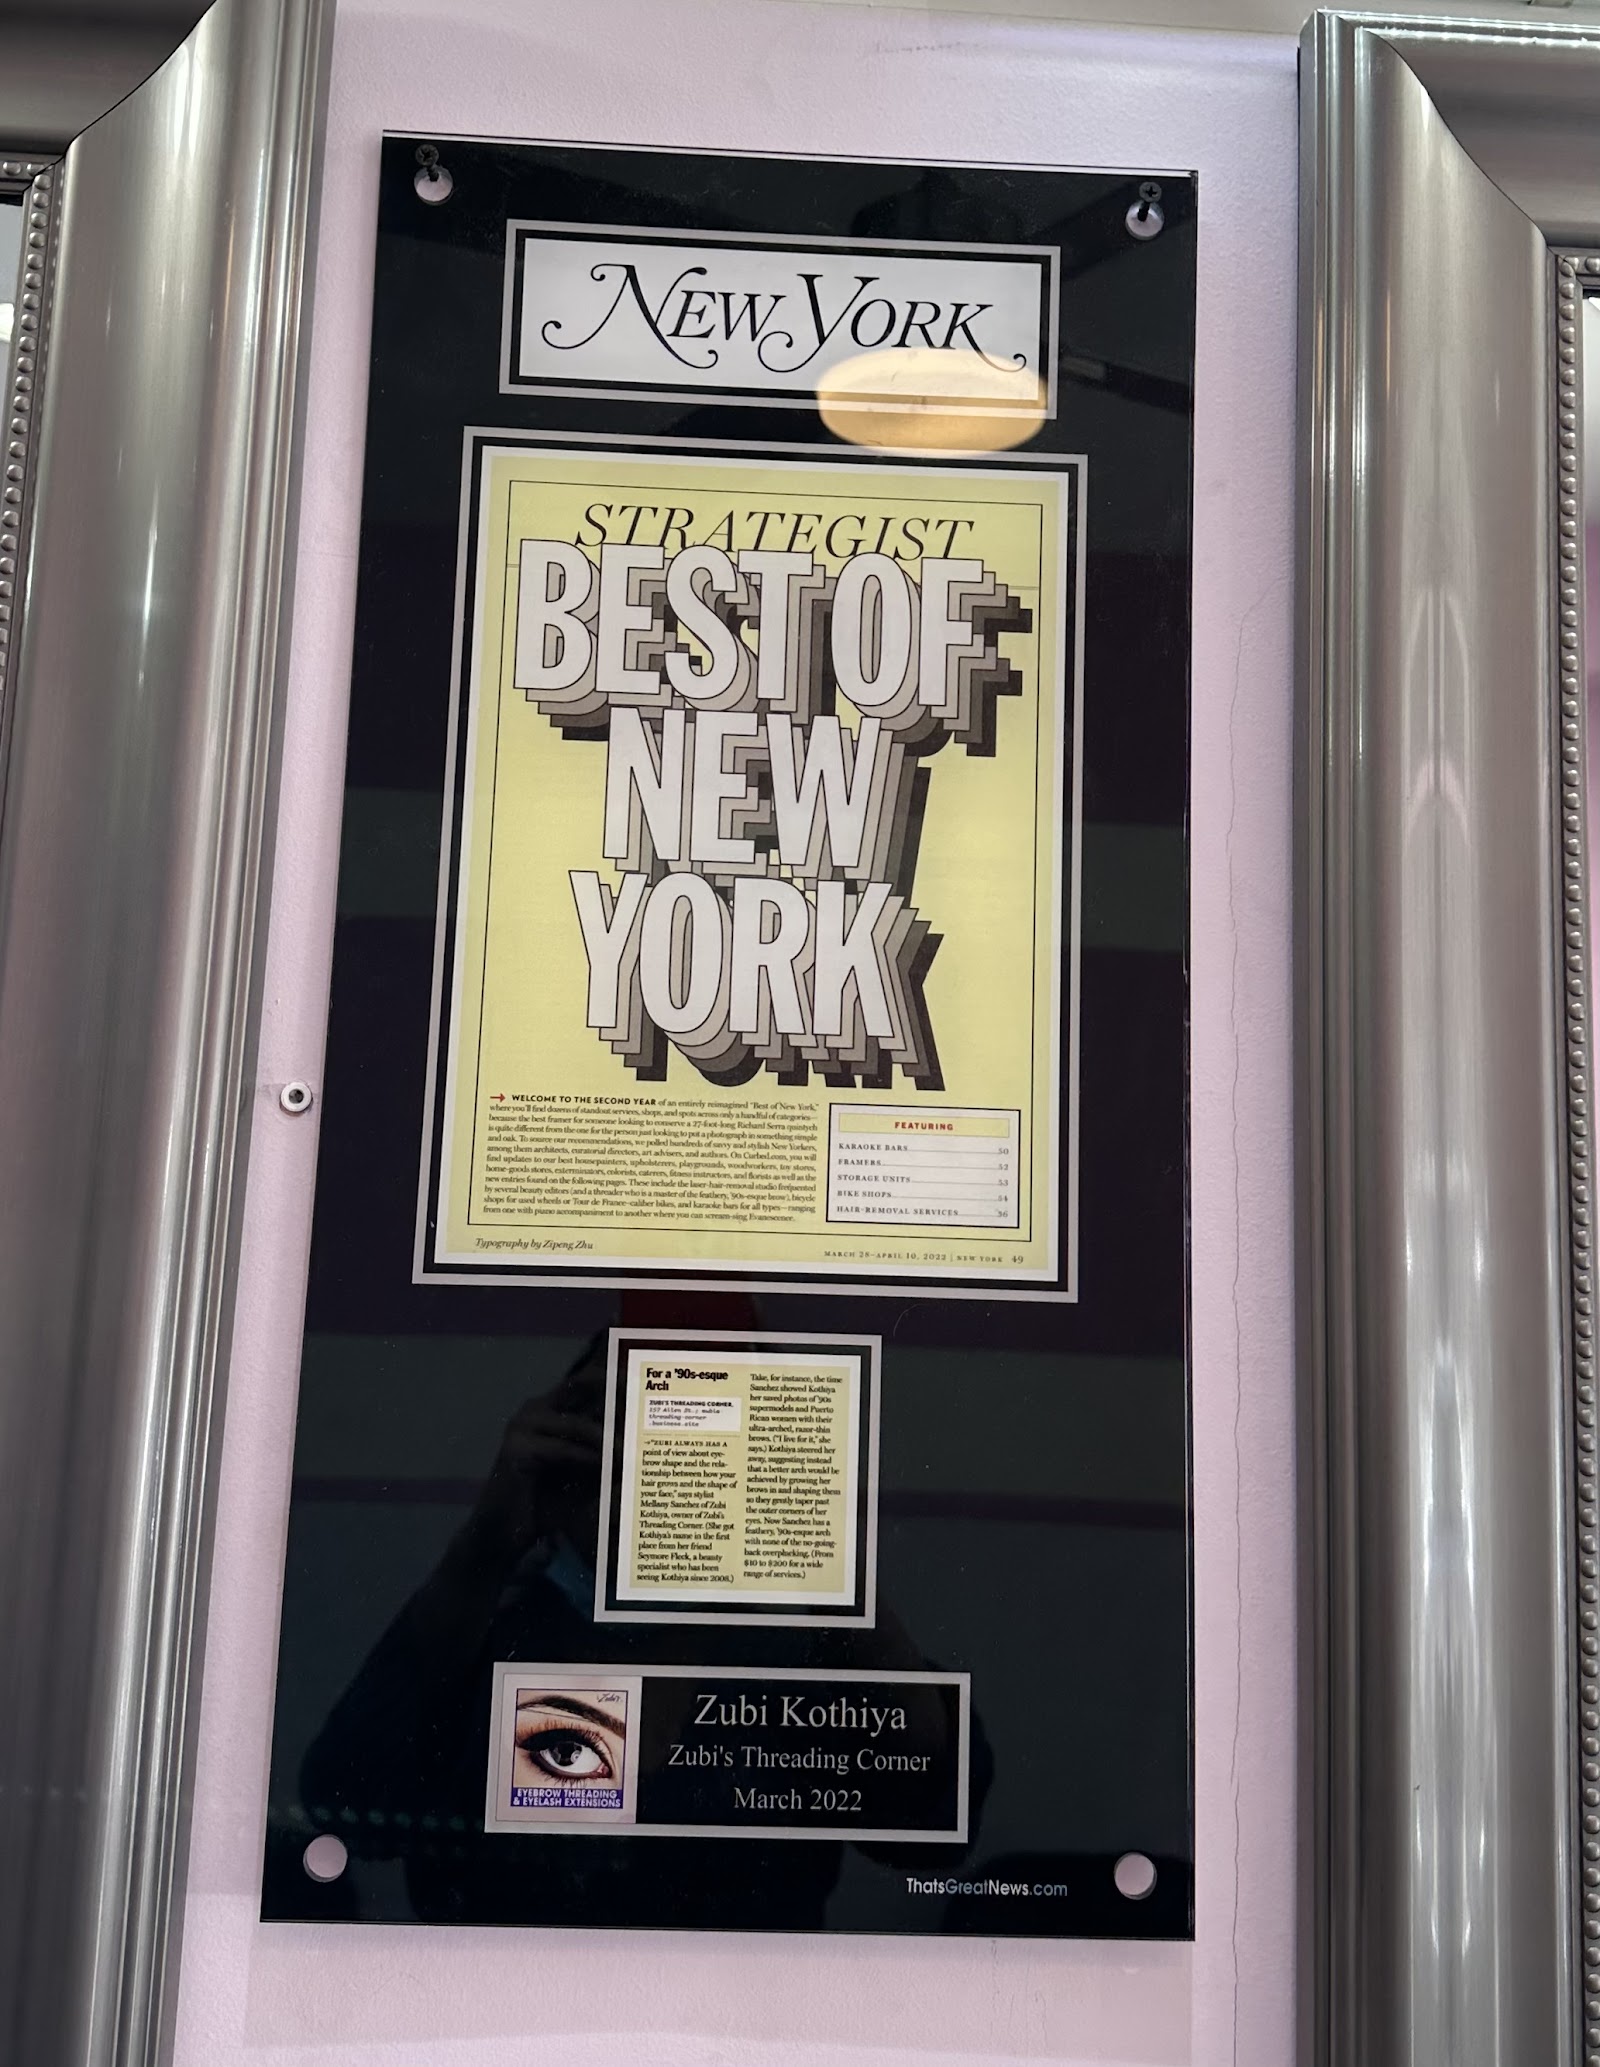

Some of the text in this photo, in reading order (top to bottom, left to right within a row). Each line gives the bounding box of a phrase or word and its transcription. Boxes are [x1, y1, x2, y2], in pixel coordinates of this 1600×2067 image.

[575, 503, 975, 562] STRATEGIST
[513, 538, 998, 717] BEST OF
[602, 706, 892, 872] NEW
[568, 869, 904, 1046] YORK
[512, 1094, 556, 1103] WELCOME
[593, 1096, 630, 1105] SECOND
[894, 1121, 954, 1131] FEATURING
[838, 1142, 882, 1151] KARAOKE
[884, 1144, 908, 1152] BARS
[838, 1158, 881, 1166] FRAMERS
[837, 1174, 879, 1182] STORAGE
[882, 1175, 911, 1183] UNITS
[837, 1190, 860, 1198] BIKE
[862, 1191, 892, 1199] SHOPS
[836, 1206, 910, 1214] HAIR-REMOVAL
[913, 1208, 958, 1216] SERVICES
[475, 1238, 593, 1251] Typography by Zipeng Zhu
[824, 1250, 855, 1258] MARCH
[906, 1252, 920, 1260] 10,
[924, 1253, 946, 1261] 2022
[1012, 1255, 1024, 1264] 49
[646, 1368, 663, 1378] For
[674, 1368, 728, 1382] '90s-esque
[645, 1380, 669, 1390] Arch
[693, 1694, 907, 1736] Zubi Kothiya
[667, 1743, 931, 1775] Zubi's Threading Corner
[516, 1788, 618, 1798] EYEBROW THREADING
[734, 1787, 862, 1812] March 2022
[512, 1797, 621, 1808] & EYELASH EXTENSIONS
[906, 1876, 1068, 1898] ThatsGreatNews.com
